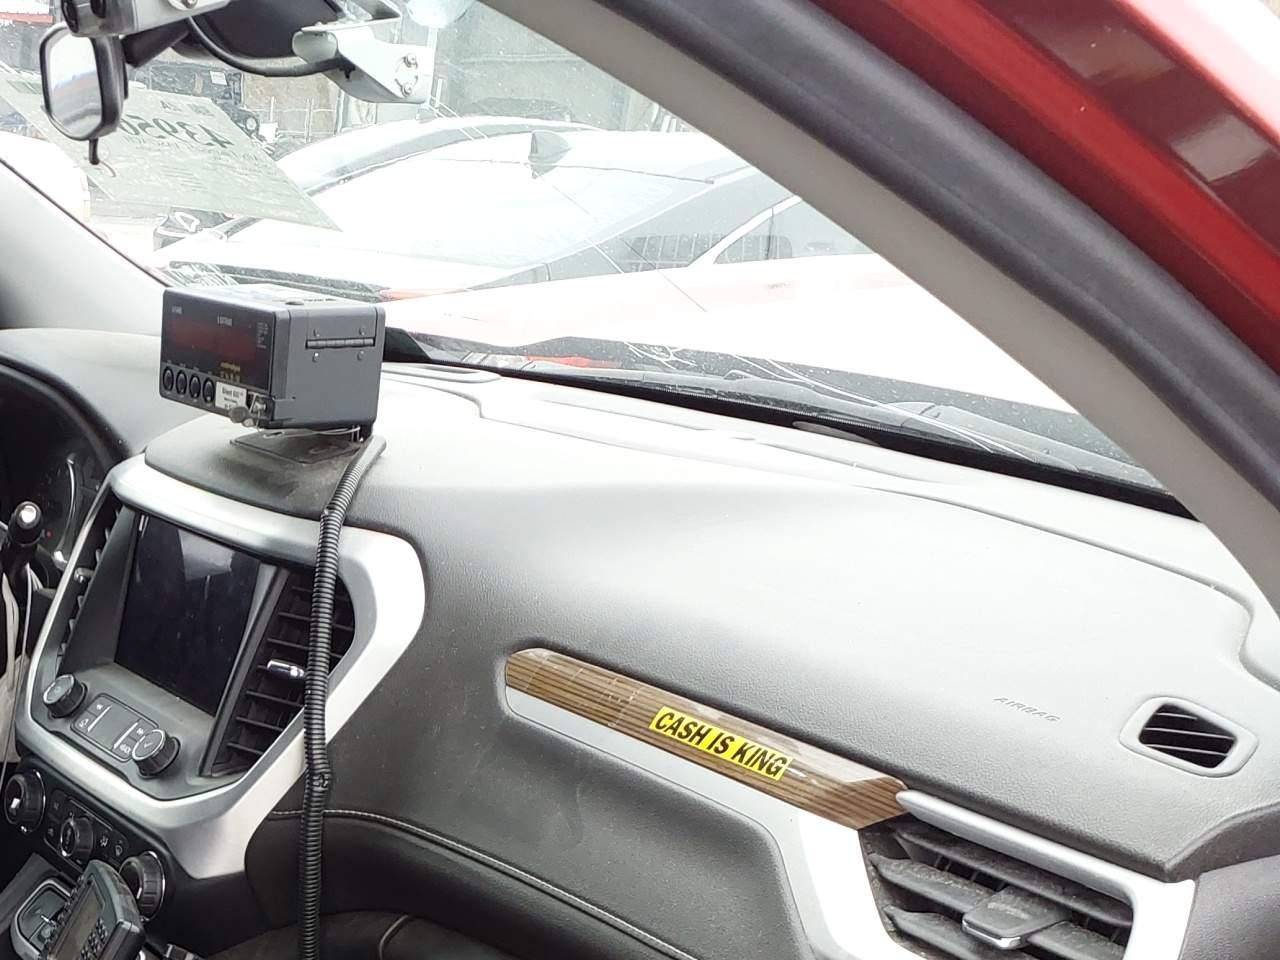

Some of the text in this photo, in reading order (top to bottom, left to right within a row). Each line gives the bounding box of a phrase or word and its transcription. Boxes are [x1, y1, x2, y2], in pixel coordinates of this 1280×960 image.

[655, 712, 788, 777] CASH IS KING
